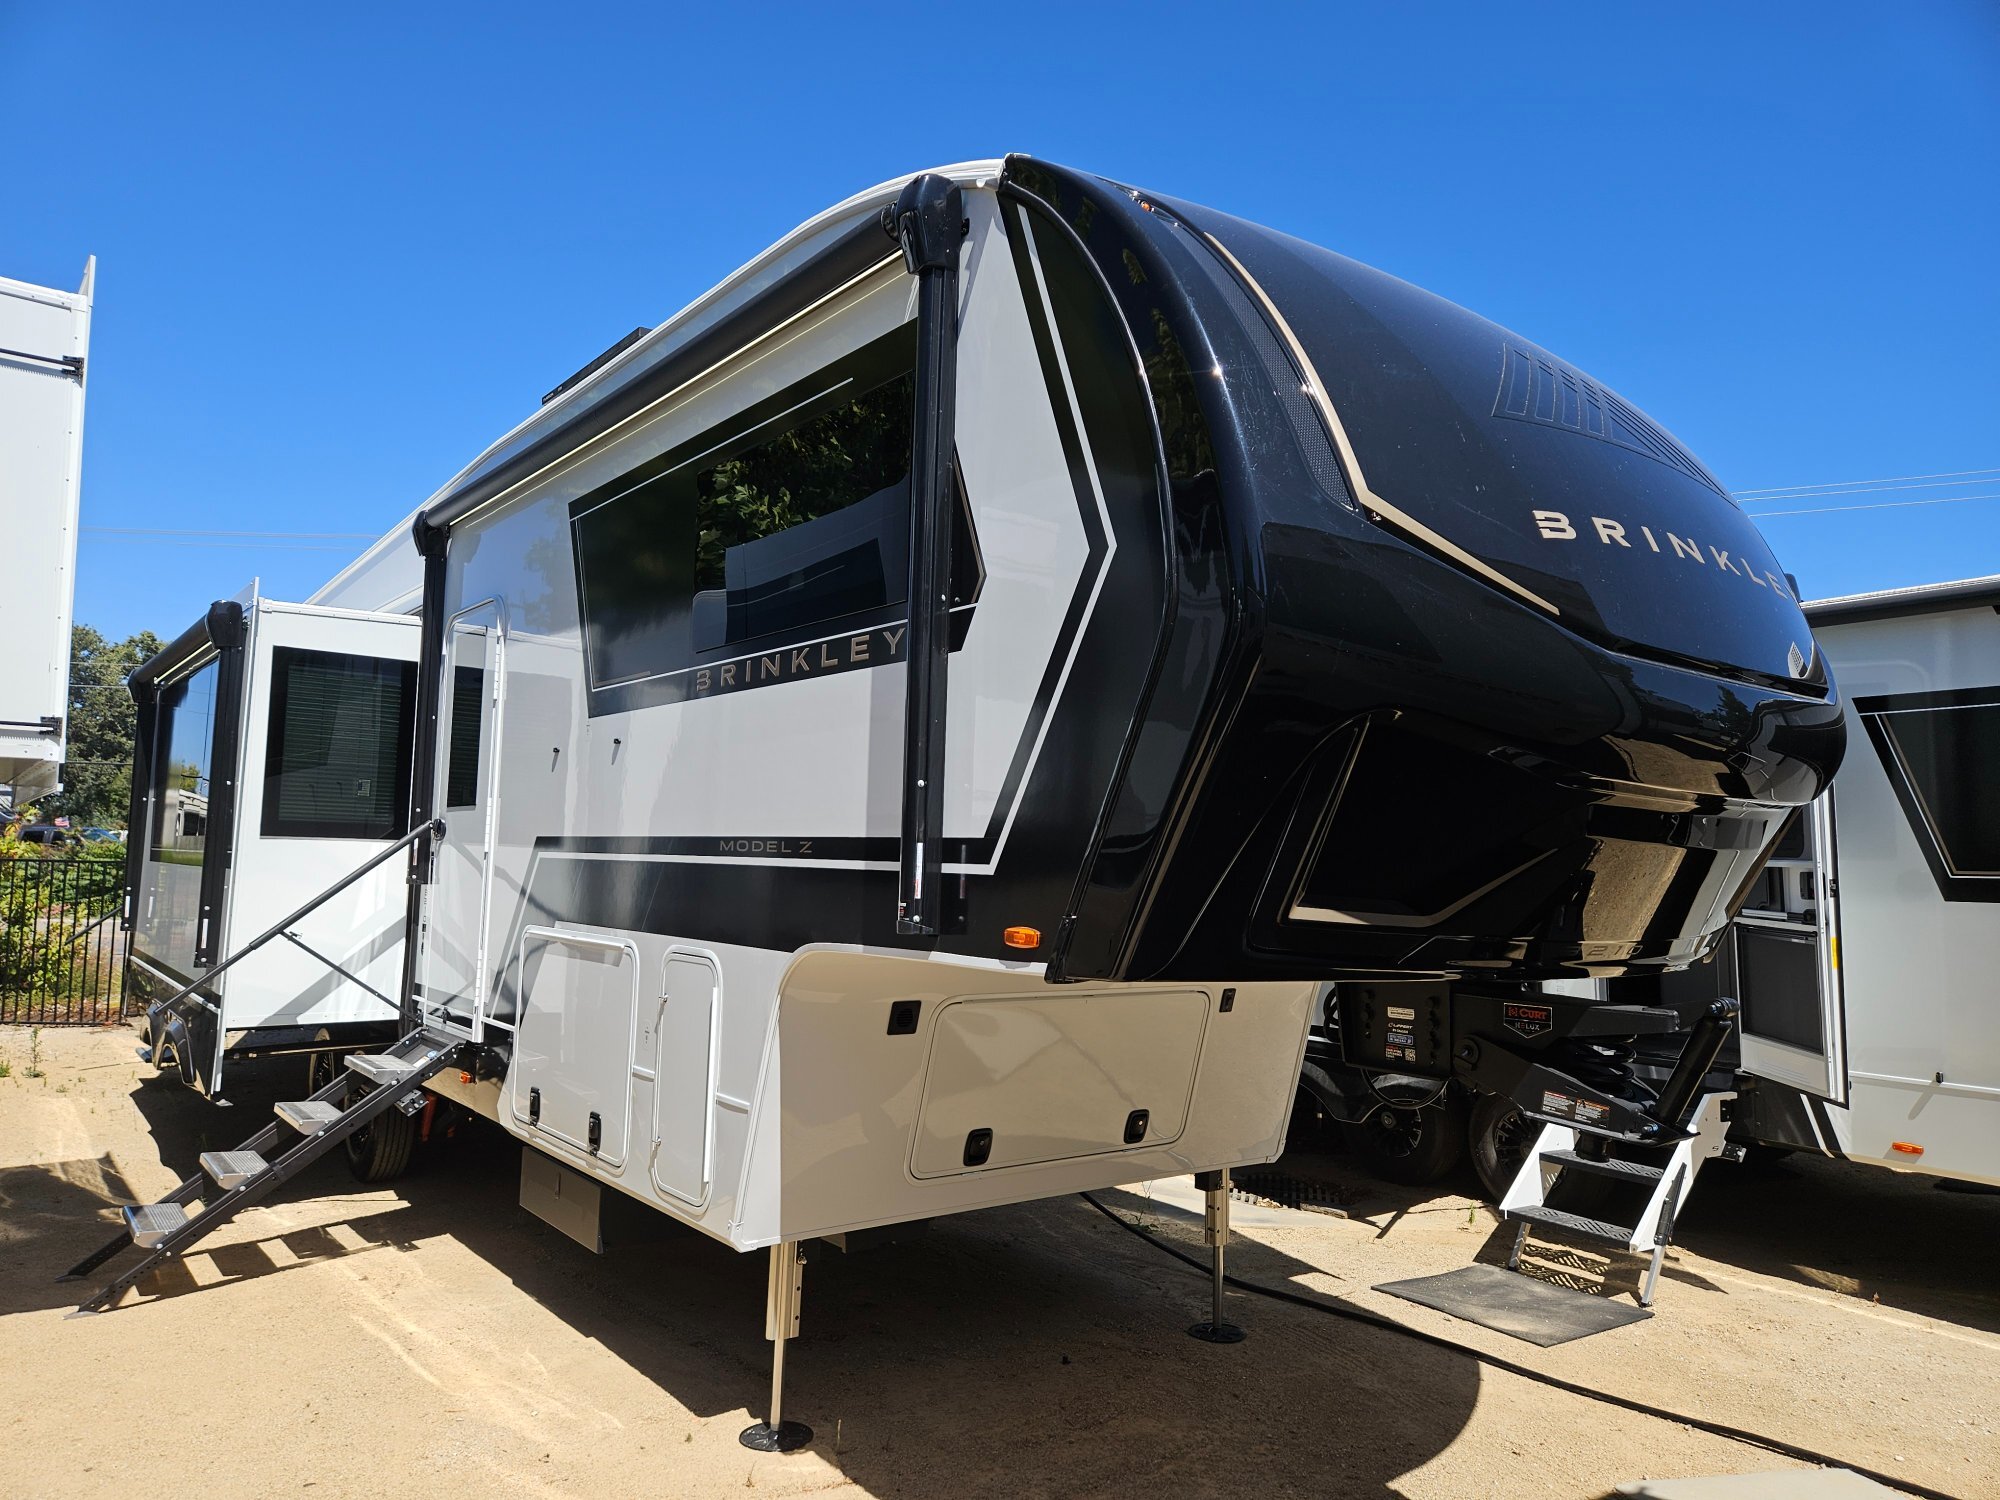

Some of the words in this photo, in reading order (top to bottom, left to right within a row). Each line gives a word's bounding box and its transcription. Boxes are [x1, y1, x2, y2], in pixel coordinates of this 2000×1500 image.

[696, 627, 906, 692] BRINKLEY
[719, 840, 792, 853] MODEL
[799, 841, 813, 853] Z
[1519, 1008, 1547, 1020] CURT
